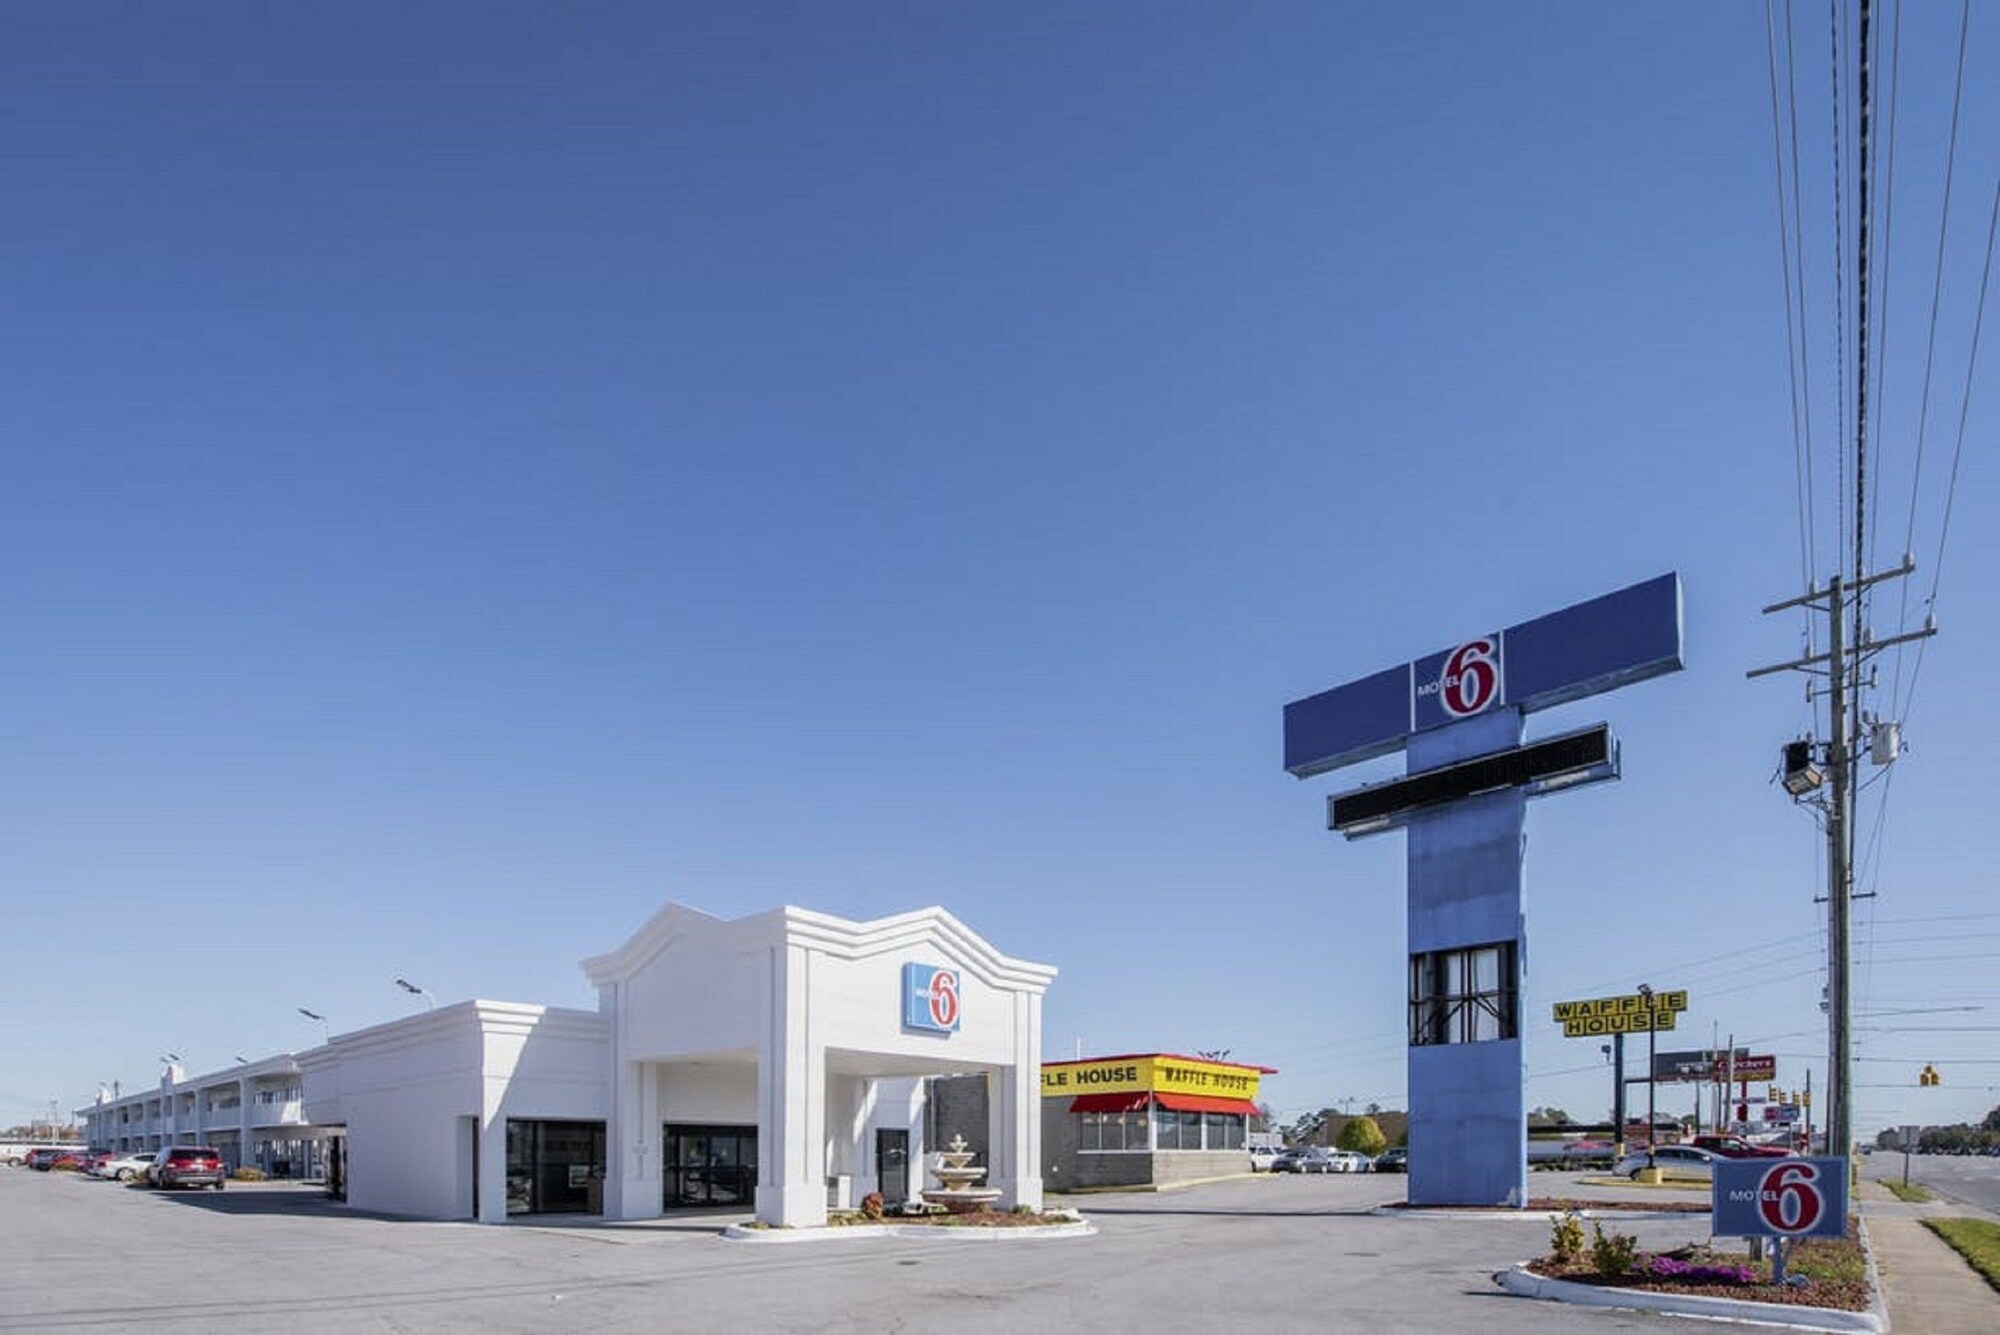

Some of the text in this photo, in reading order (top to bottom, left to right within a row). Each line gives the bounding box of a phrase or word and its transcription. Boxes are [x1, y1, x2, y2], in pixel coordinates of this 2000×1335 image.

[1441, 639, 1498, 717] 6
[930, 970, 959, 1027] 6
[1567, 1012, 1671, 1034] HOUSE
[1076, 1066, 1137, 1084] HOUSE
[1165, 1067, 1207, 1086] WAFFLE
[1759, 1162, 1823, 1233] 6
